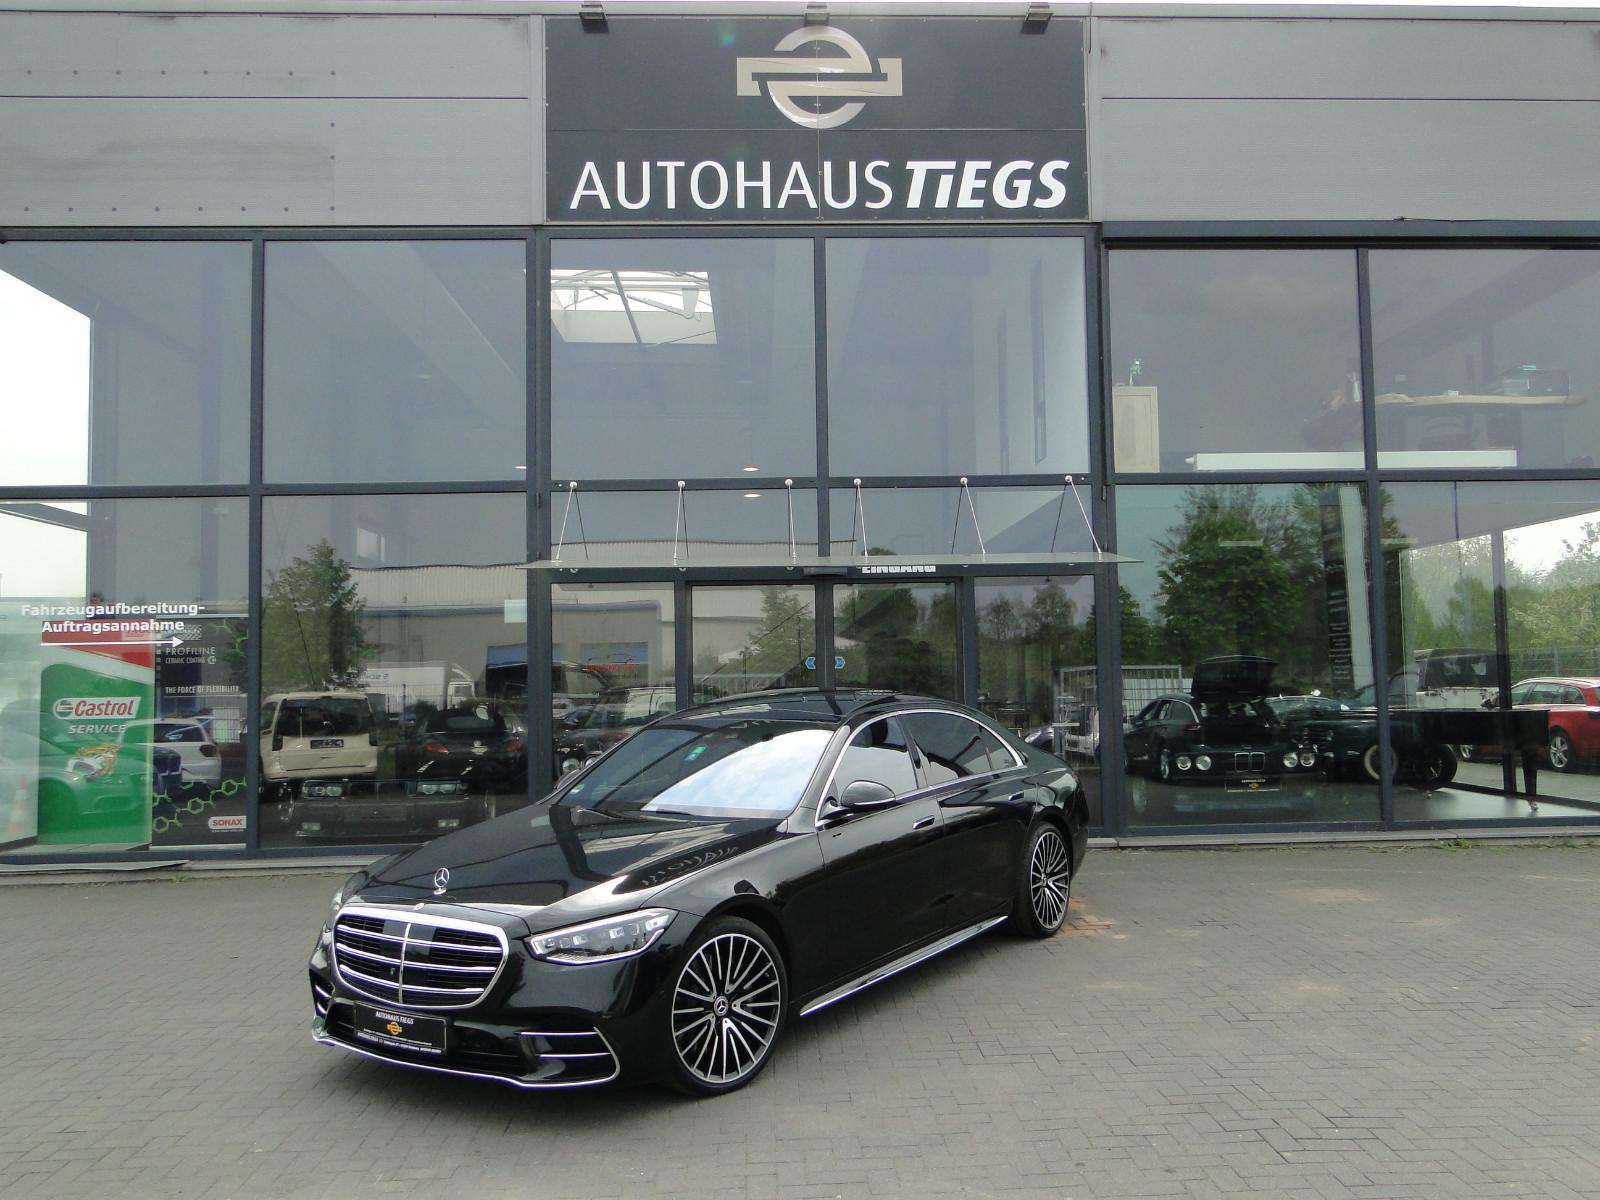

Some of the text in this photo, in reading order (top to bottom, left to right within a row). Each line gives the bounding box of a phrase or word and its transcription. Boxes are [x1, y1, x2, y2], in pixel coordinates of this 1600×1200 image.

[569, 160, 893, 210] AUTOHAUS
[20, 602, 206, 618] Fahrzeugaufbereitung-
[41, 619, 185, 633] Auftragsannahme
[165, 646, 217, 656] PROFILINE
[165, 686, 177, 694] THE
[177, 686, 196, 694] FORCE
[74, 699, 135, 717] Castrol
[67, 724, 129, 734] SERVICE
[212, 818, 243, 827] SONAX
[375, 1011, 399, 1022] AUTOHAUS
